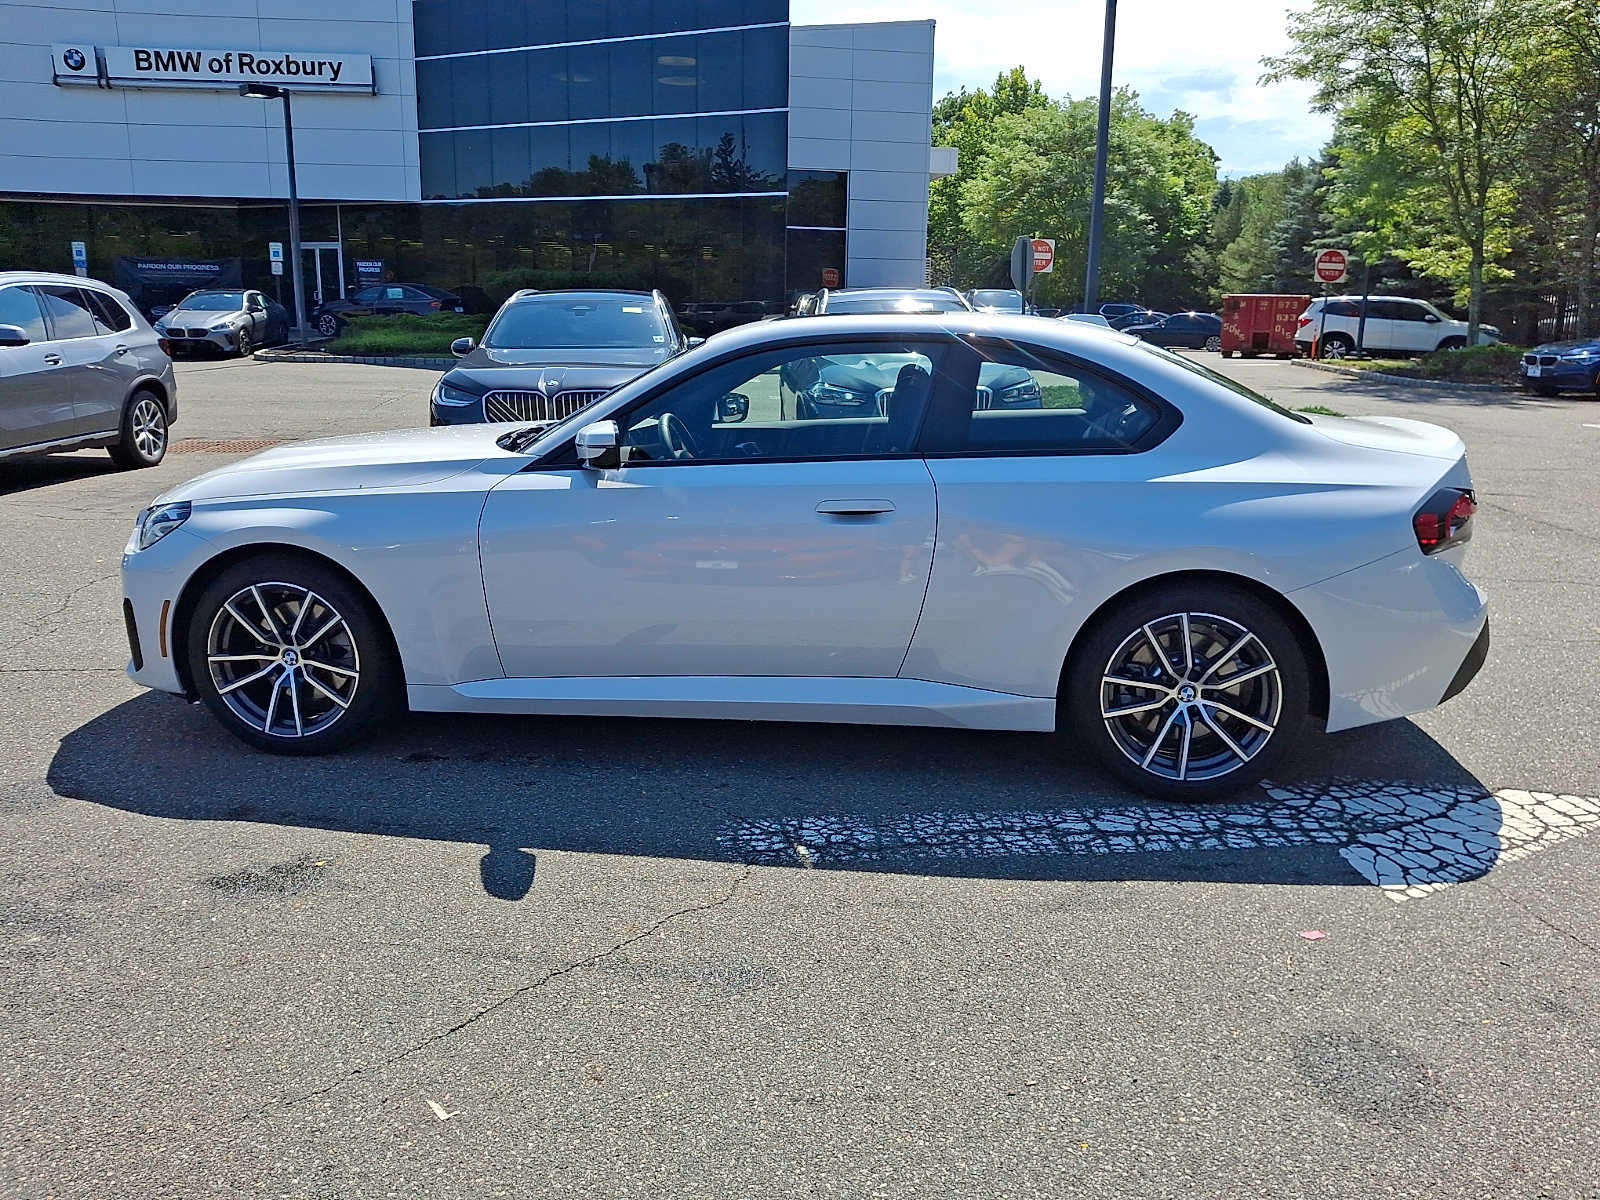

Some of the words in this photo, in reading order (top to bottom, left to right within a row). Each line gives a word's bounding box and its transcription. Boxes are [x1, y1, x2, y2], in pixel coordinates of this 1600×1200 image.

[134, 50, 201, 72] BMW
[208, 53, 232, 73] of
[238, 53, 342, 81] Roxbury
[1278, 301, 1298, 309] 973
[1223, 322, 1246, 341] SONS
